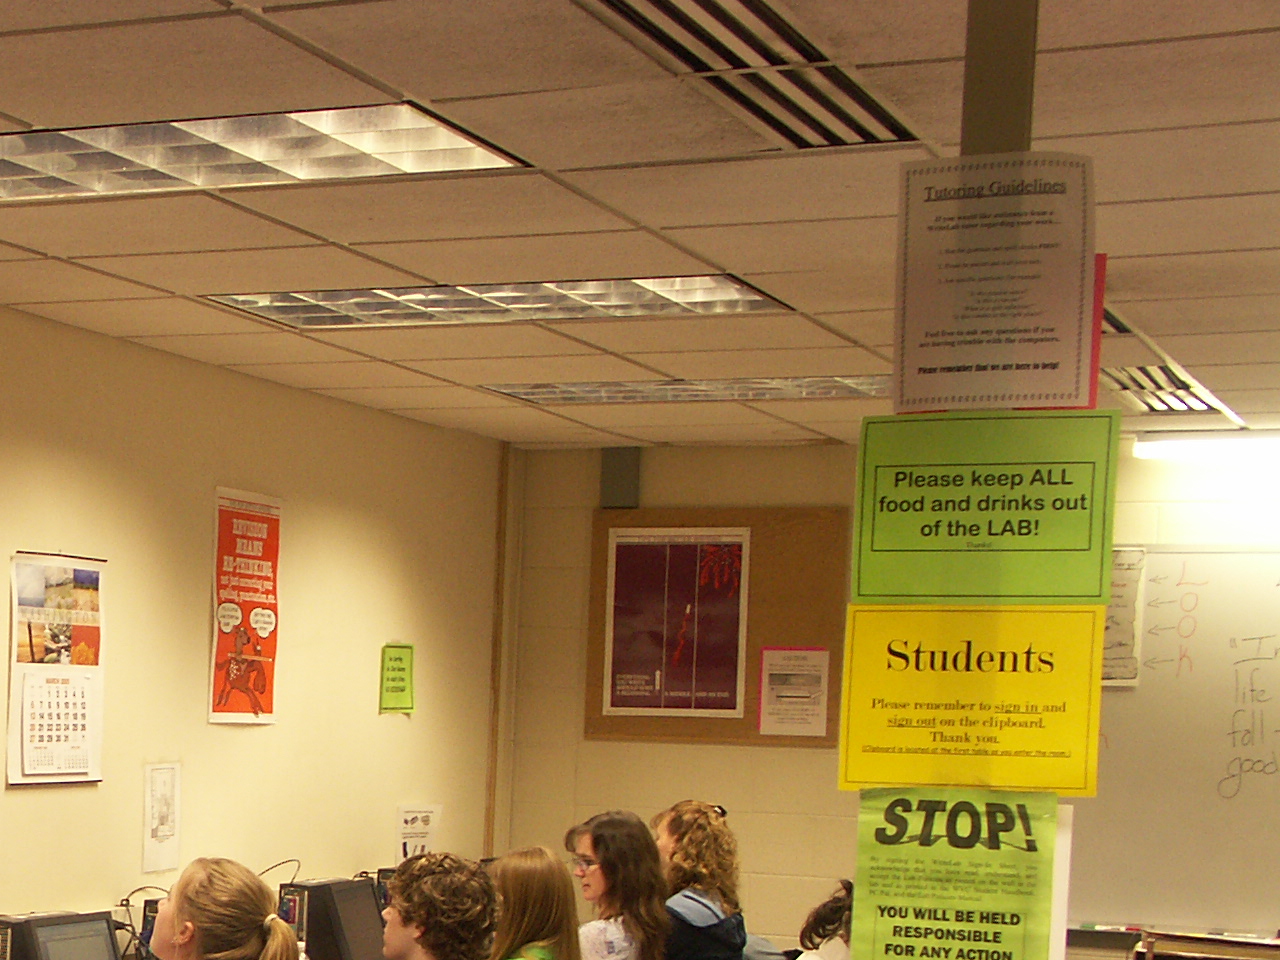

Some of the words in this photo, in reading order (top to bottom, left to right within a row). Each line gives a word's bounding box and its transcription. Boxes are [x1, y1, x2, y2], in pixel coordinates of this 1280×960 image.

[924, 184, 985, 201] Tutoring
[989, 179, 1066, 197] Guidelines
[894, 471, 964, 487] Please
[971, 470, 1024, 490] keep
[1029, 468, 1074, 486] ALL
[879, 495, 925, 512] food
[931, 496, 971, 512] and
[977, 494, 1045, 511] drinks
[1051, 493, 1088, 511] out
[920, 520, 940, 537] of
[947, 520, 980, 537] the
[987, 520, 1039, 536] LAB!
[886, 639, 1055, 674] Students
[1233, 667, 1273, 705] life
[872, 698, 910, 709] Please
[914, 700, 976, 711] remember
[979, 702, 991, 711] to
[995, 701, 1020, 714] sign
[1025, 701, 1038, 712] in
[1042, 702, 1066, 713] and
[887, 714, 912, 728] sign
[916, 717, 936, 727] out
[939, 718, 955, 727] on
[959, 716, 979, 726] the
[982, 716, 1045, 730] clipboard.
[1227, 708, 1265, 748] fall
[929, 731, 970, 743] Thank
[976, 735, 1000, 746] you.
[875, 798, 1038, 852] STOP!
[877, 905, 908, 918] YOU
[913, 908, 950, 921] WILL
[955, 910, 974, 922] BE
[979, 912, 1020, 926] HELD
[892, 926, 1002, 944] RESPONSIBLE
[884, 943, 915, 957] FOR
[919, 946, 952, 959] ANY
